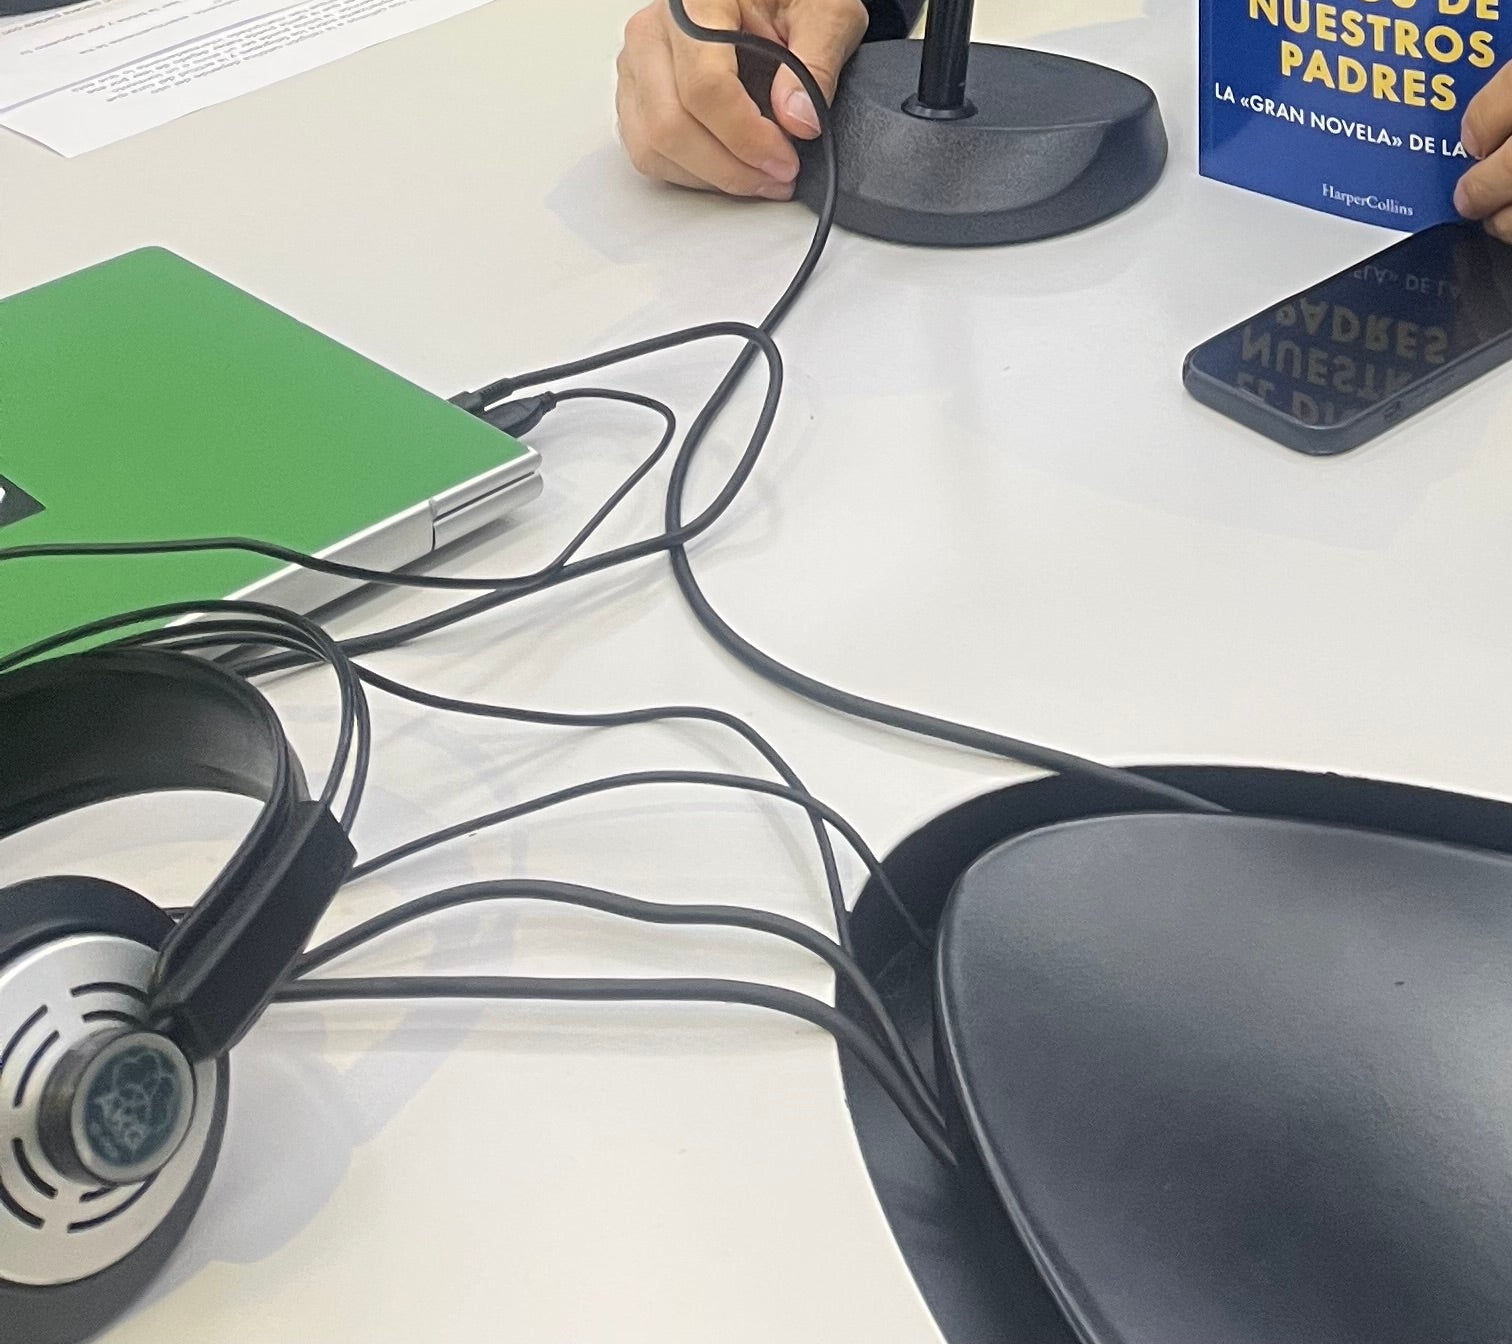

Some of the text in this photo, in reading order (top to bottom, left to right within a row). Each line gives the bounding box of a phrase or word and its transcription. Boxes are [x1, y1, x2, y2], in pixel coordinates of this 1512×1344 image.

[1281, 40, 1457, 112] PADRES
[1214, 82, 1468, 159] LA «GRAN NOVELA» DE LA
[1322, 183, 1414, 217] HarperCollins
